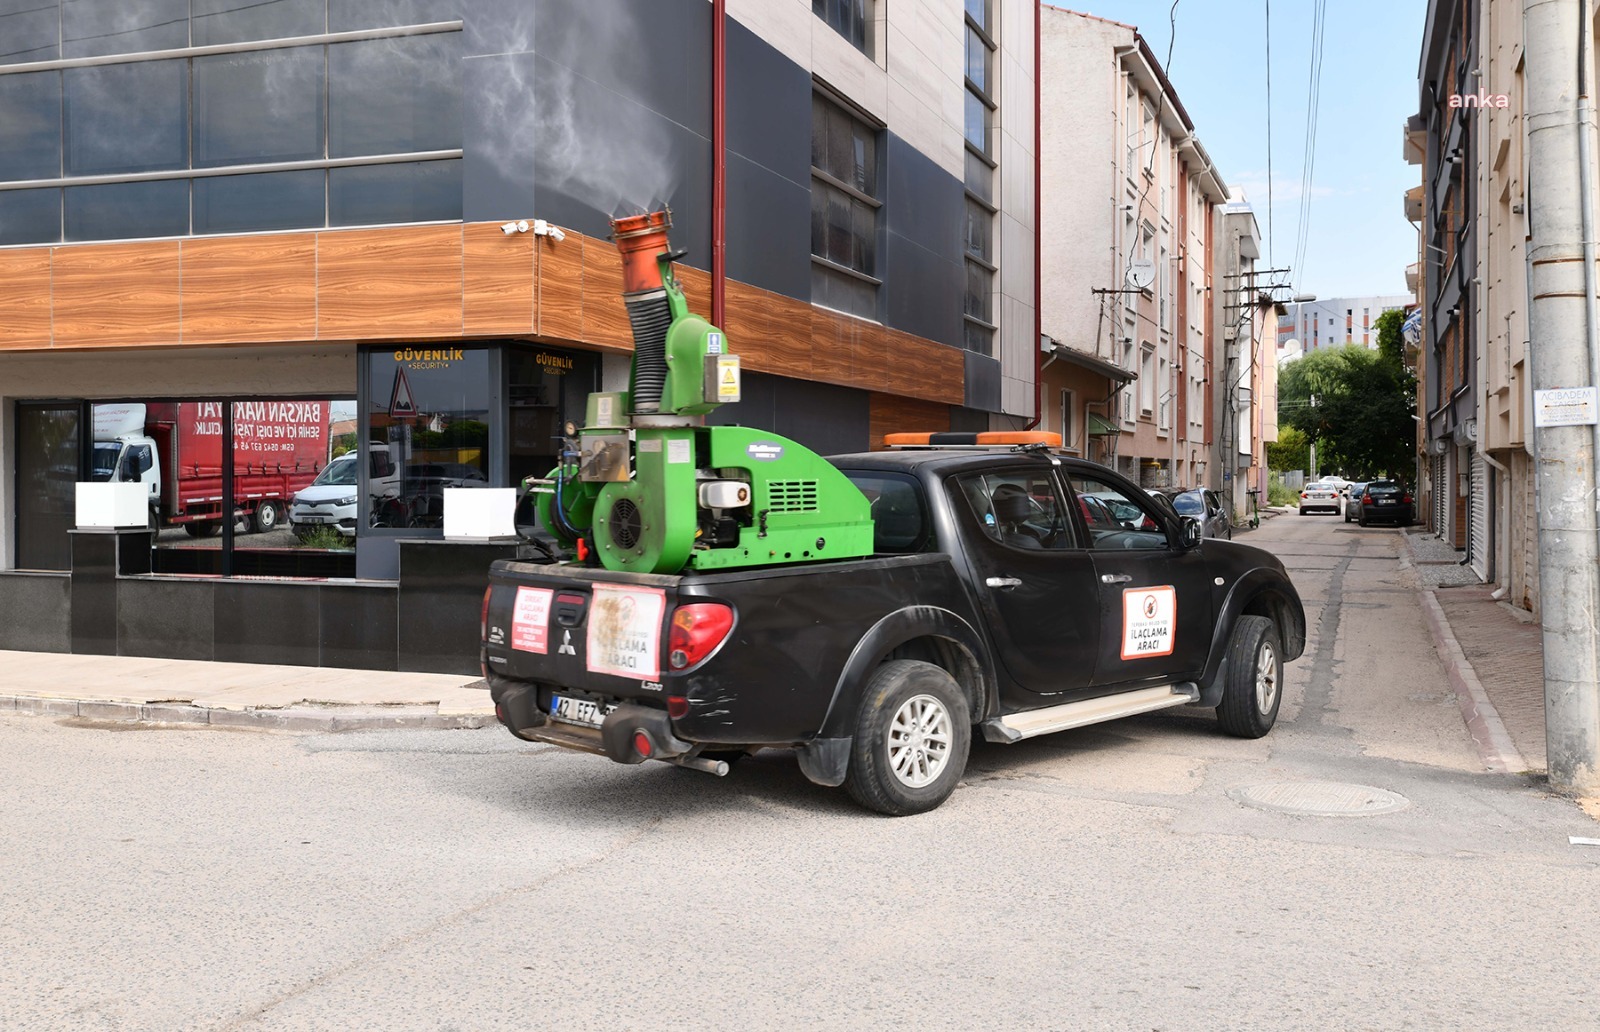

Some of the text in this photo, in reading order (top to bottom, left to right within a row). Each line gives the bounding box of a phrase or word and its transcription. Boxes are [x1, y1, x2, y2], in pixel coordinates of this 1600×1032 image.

[394, 347, 464, 361] GÜVENLİK
[535, 351, 573, 369] GÜVENLİK
[1541, 390, 1592, 401] ACIBADEM
[1130, 627, 1168, 640] İLAÇLAMA
[1137, 640, 1160, 651] ARACI
[607, 653, 637, 669] ARACI
[557, 699, 570, 718] 42
[577, 702, 597, 723] EFZ
